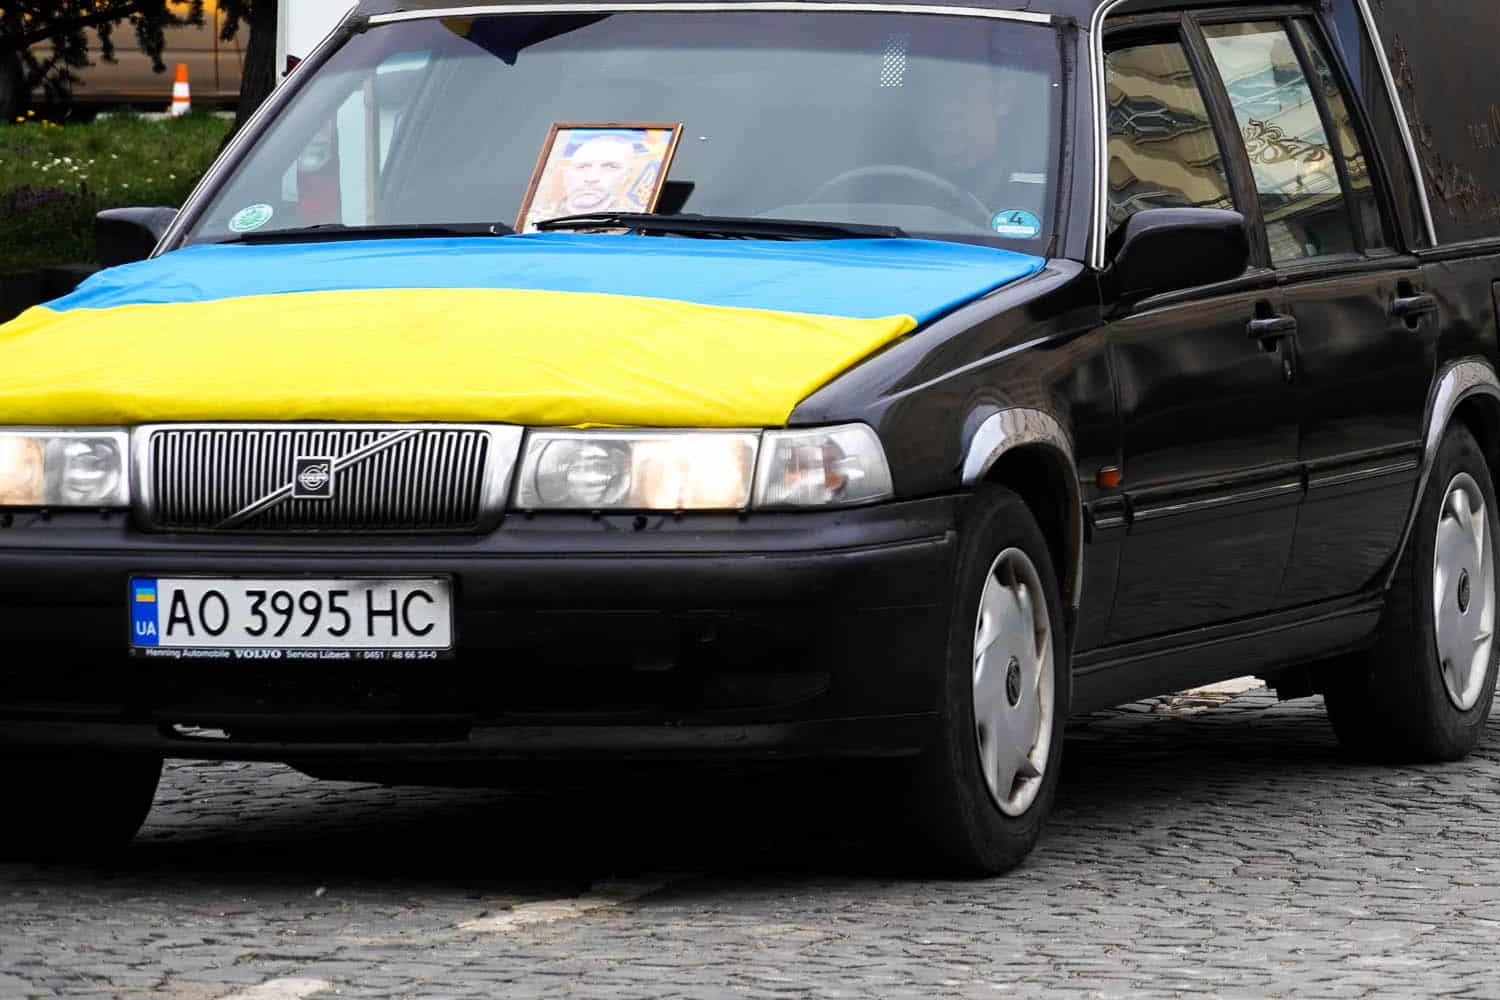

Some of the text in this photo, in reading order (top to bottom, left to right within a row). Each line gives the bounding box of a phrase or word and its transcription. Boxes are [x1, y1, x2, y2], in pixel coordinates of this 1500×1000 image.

[166, 589, 435, 637] AO 3995 HC
[136, 621, 157, 636] UA
[182, 648, 230, 658] Automobile
[234, 648, 282, 659] VOLVO
[286, 650, 317, 659] Service
